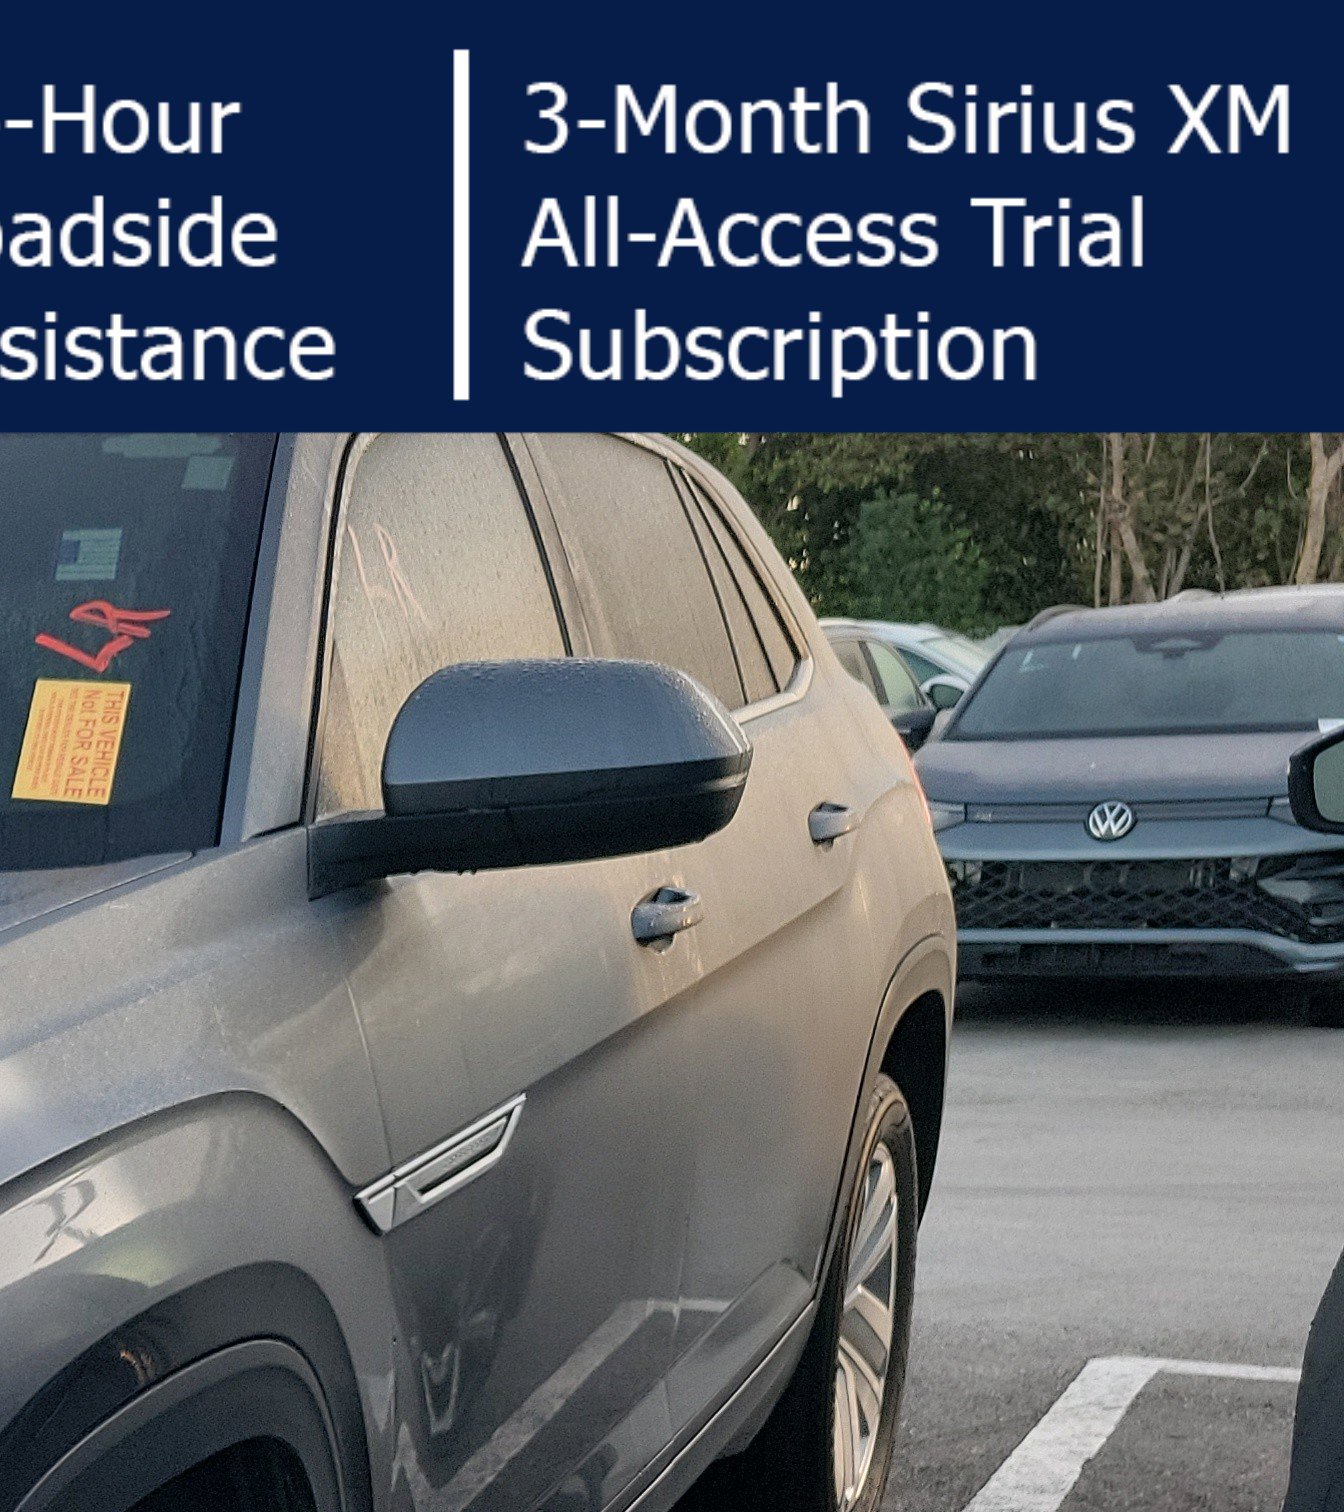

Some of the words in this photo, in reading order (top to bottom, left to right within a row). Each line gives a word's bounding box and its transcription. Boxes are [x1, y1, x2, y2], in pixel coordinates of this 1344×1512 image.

[100, 690, 124, 724] THIS
[72, 718, 97, 751] FOR
[64, 756, 89, 799] SALE
[87, 730, 118, 799] VEHICLE
